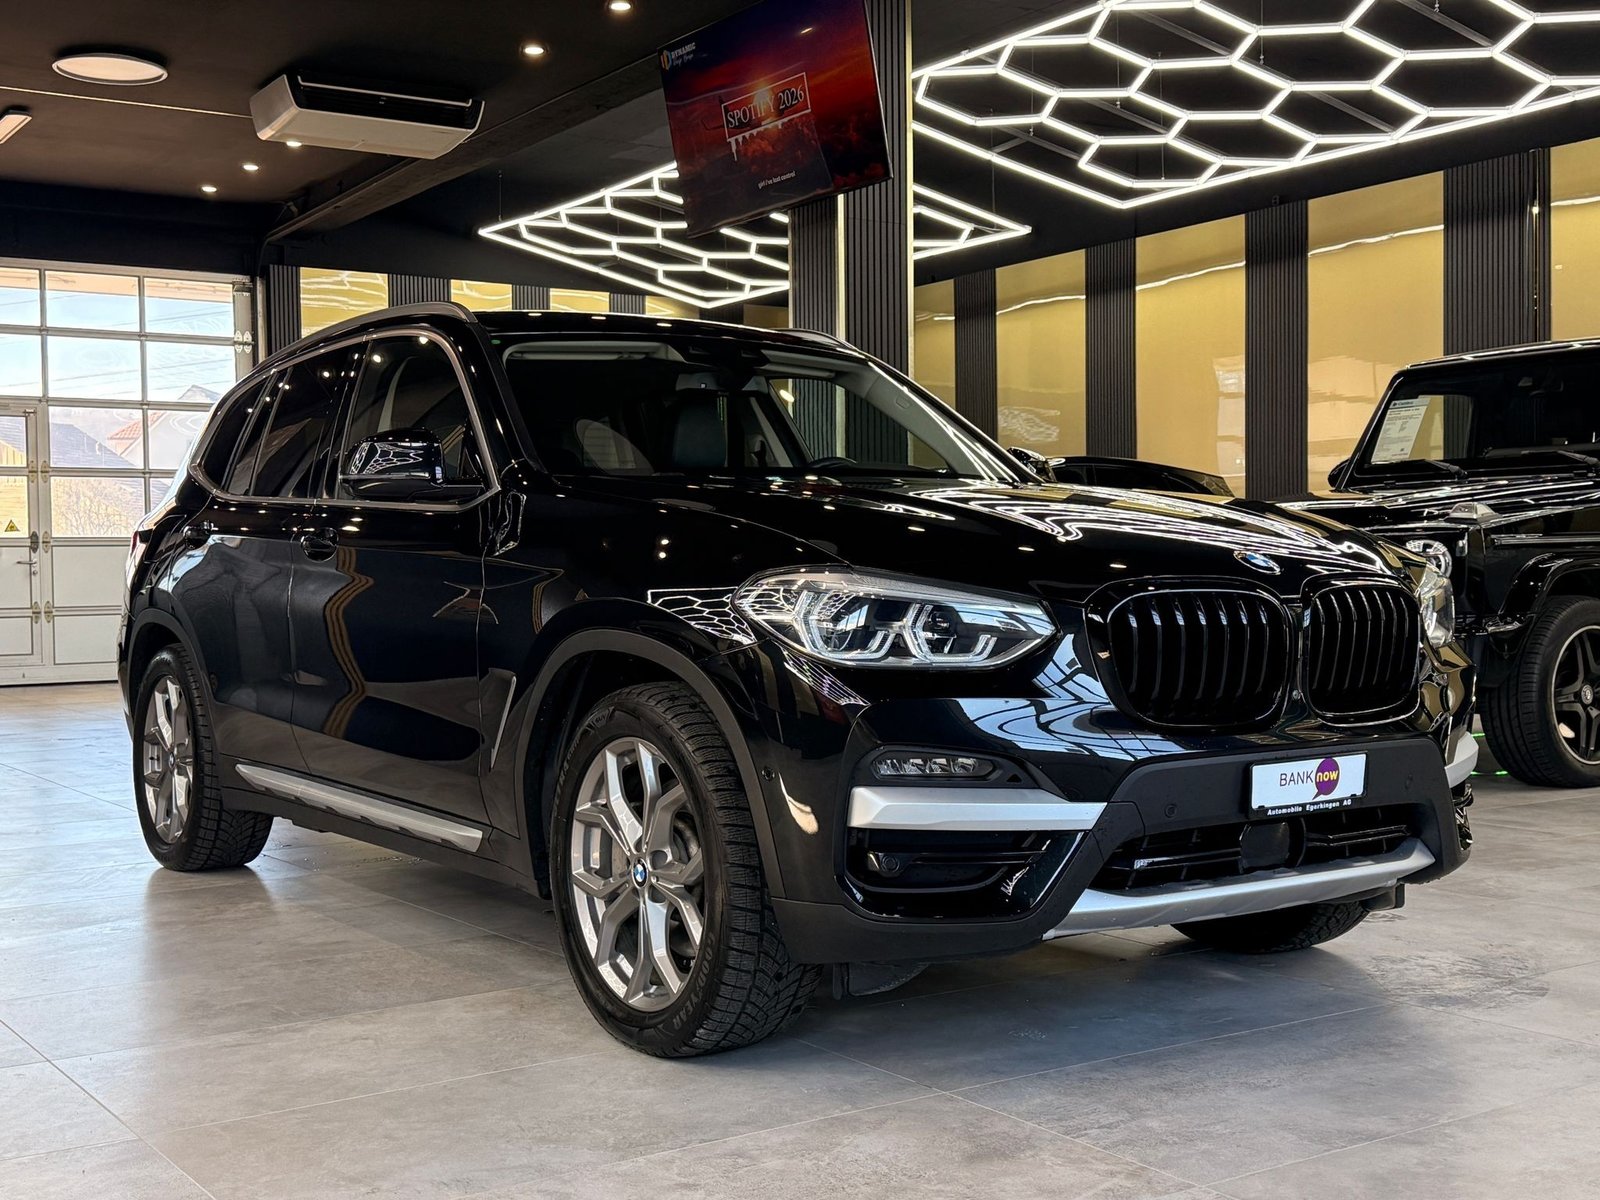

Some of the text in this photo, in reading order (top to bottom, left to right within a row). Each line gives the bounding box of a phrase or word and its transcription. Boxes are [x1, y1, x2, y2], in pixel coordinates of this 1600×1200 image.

[778, 85, 805, 110] 2026
[1279, 770, 1339, 787] BANK now
[1267, 805, 1302, 816] Automobile
[1306, 800, 1340, 812] Egerkingen
[673, 932, 715, 1030] GOODYEAR
